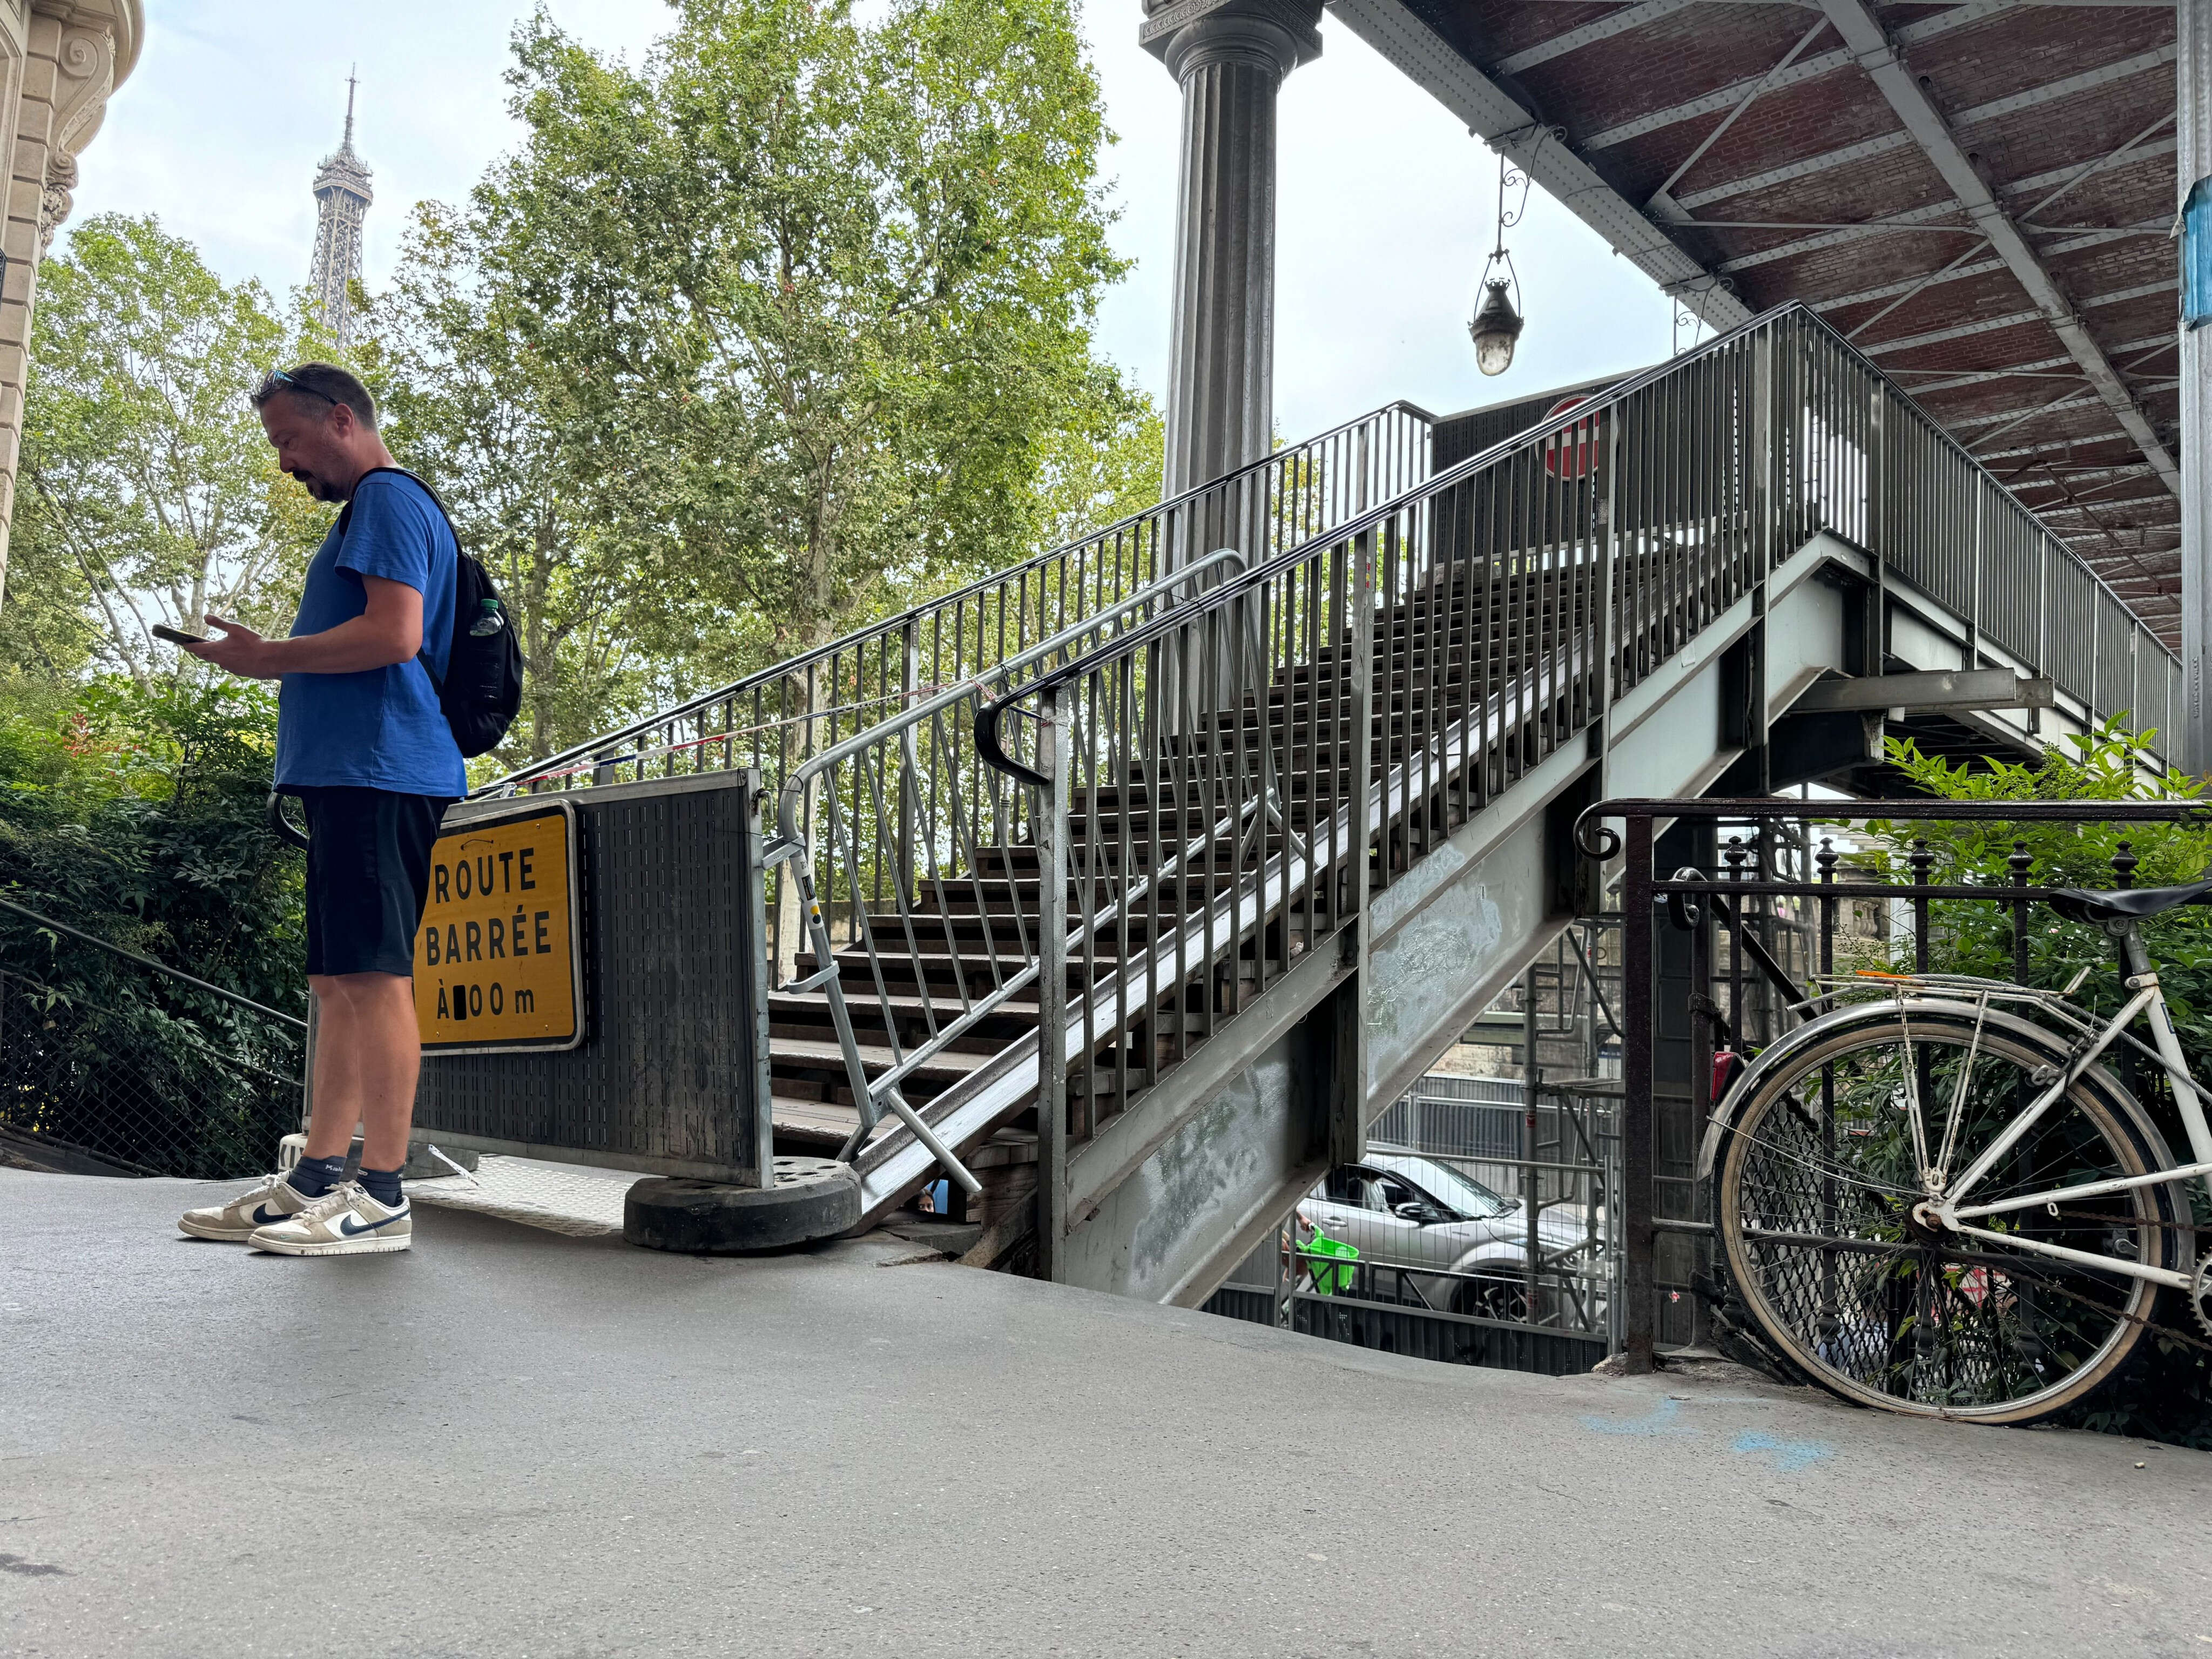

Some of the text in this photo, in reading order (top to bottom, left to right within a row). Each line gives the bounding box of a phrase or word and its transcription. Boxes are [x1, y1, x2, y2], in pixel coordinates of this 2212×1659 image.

[435, 848, 536, 904] ROUTE
[426, 905, 551, 966] BARRÉE
[436, 979, 535, 1021] À 00 m
